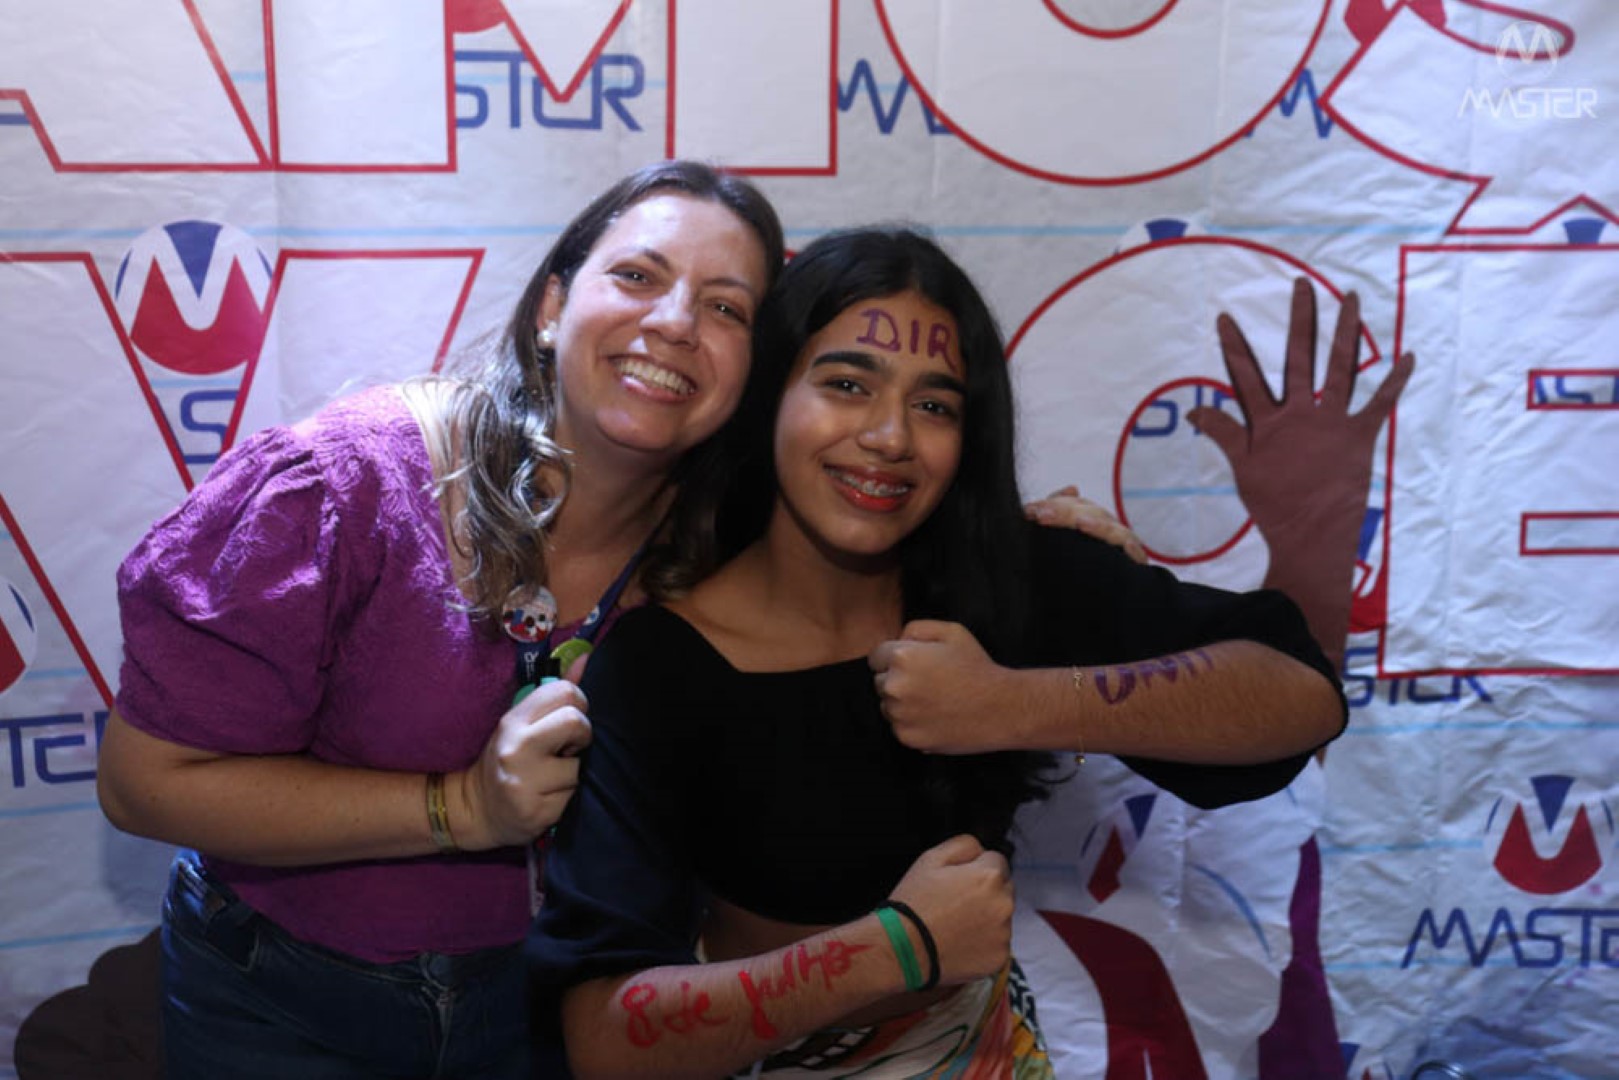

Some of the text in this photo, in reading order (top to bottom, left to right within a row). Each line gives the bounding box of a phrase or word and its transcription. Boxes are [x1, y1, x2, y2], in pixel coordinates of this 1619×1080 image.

[453, 50, 646, 132] STER
[856, 308, 960, 377] DIR
[1401, 907, 1619, 970] MAST
[622, 982, 662, 1049] 8
[663, 980, 732, 1034] de
